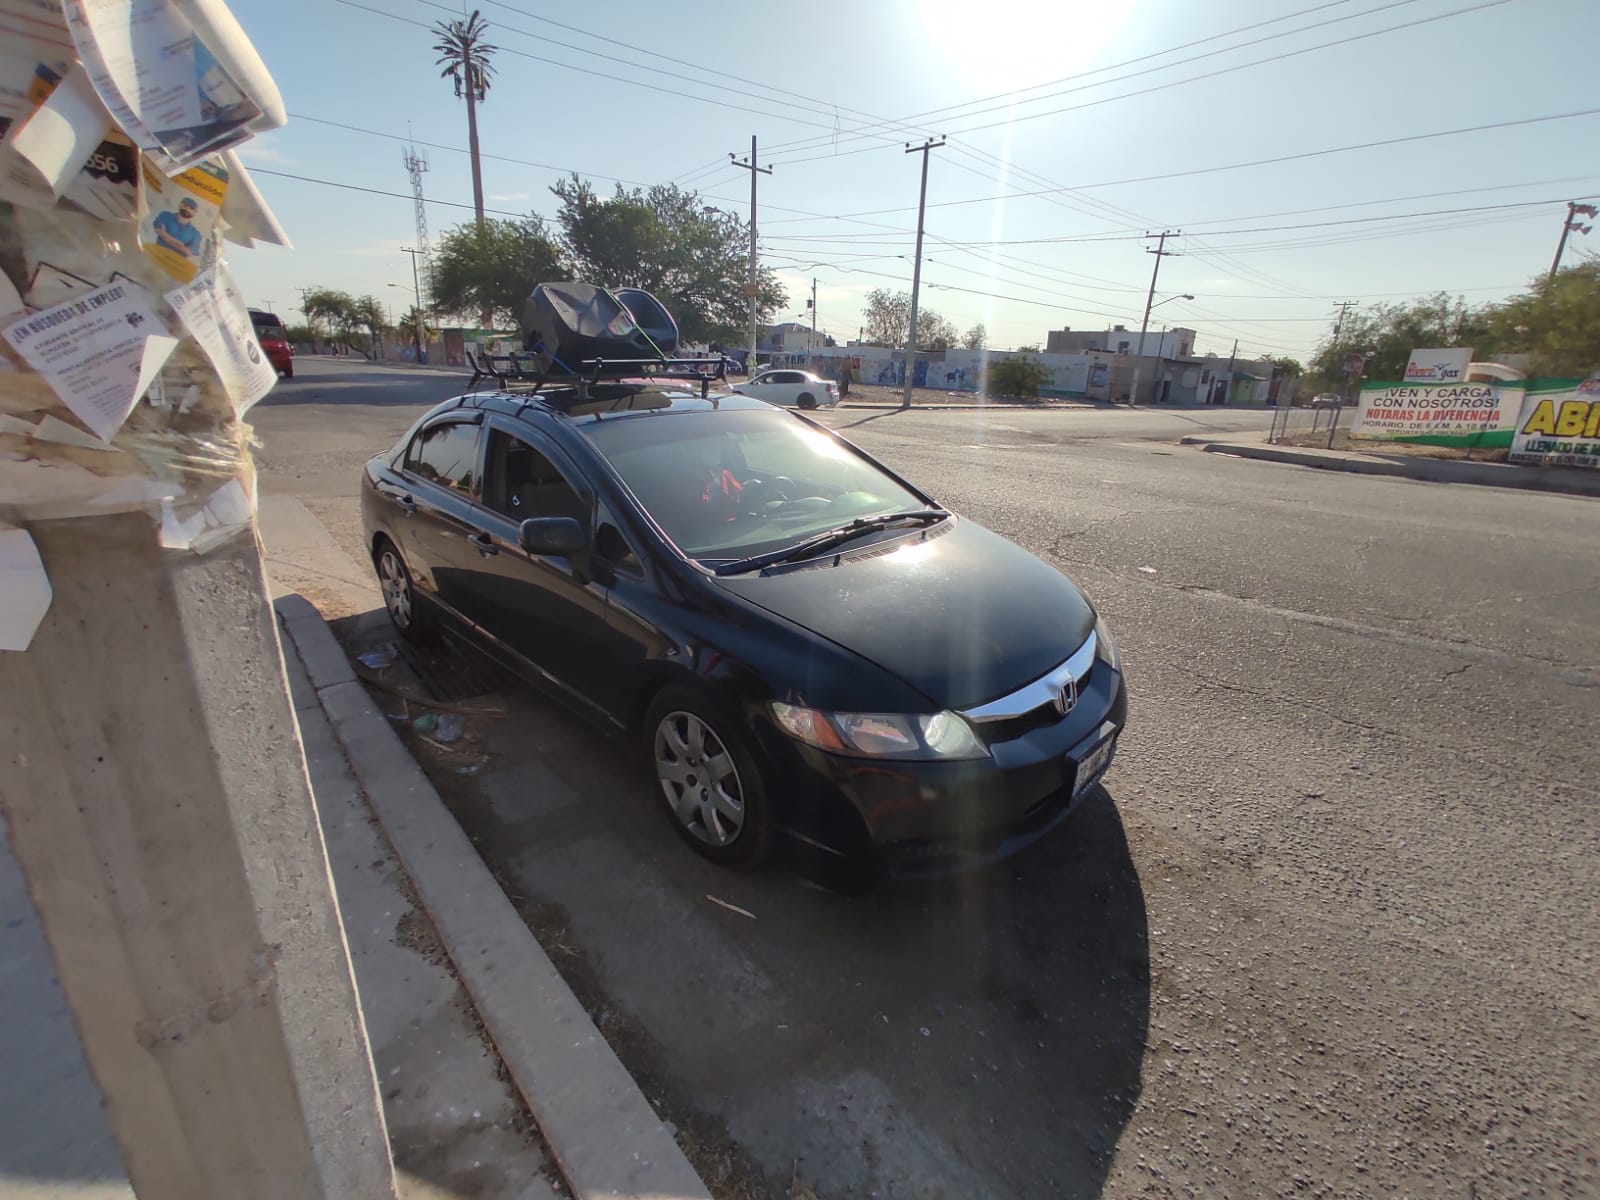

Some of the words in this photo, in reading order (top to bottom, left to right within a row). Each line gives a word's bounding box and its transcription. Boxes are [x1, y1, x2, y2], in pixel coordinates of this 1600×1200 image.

[27, 306, 79, 333] BÚSQUEDA
[76, 300, 92, 315] DE
[1385, 387, 1418, 398] ¡VEN
[1424, 388, 1433, 398] Y
[1437, 387, 1492, 398] CARGA
[1373, 397, 1403, 408] CON
[1407, 398, 1500, 409] NOSOTROS!
[1366, 408, 1415, 421] NOTARAS
[1416, 410, 1431, 421] LA
[1520, 399, 1600, 439] ABI
[1361, 420, 1406, 429] HORARIO:
